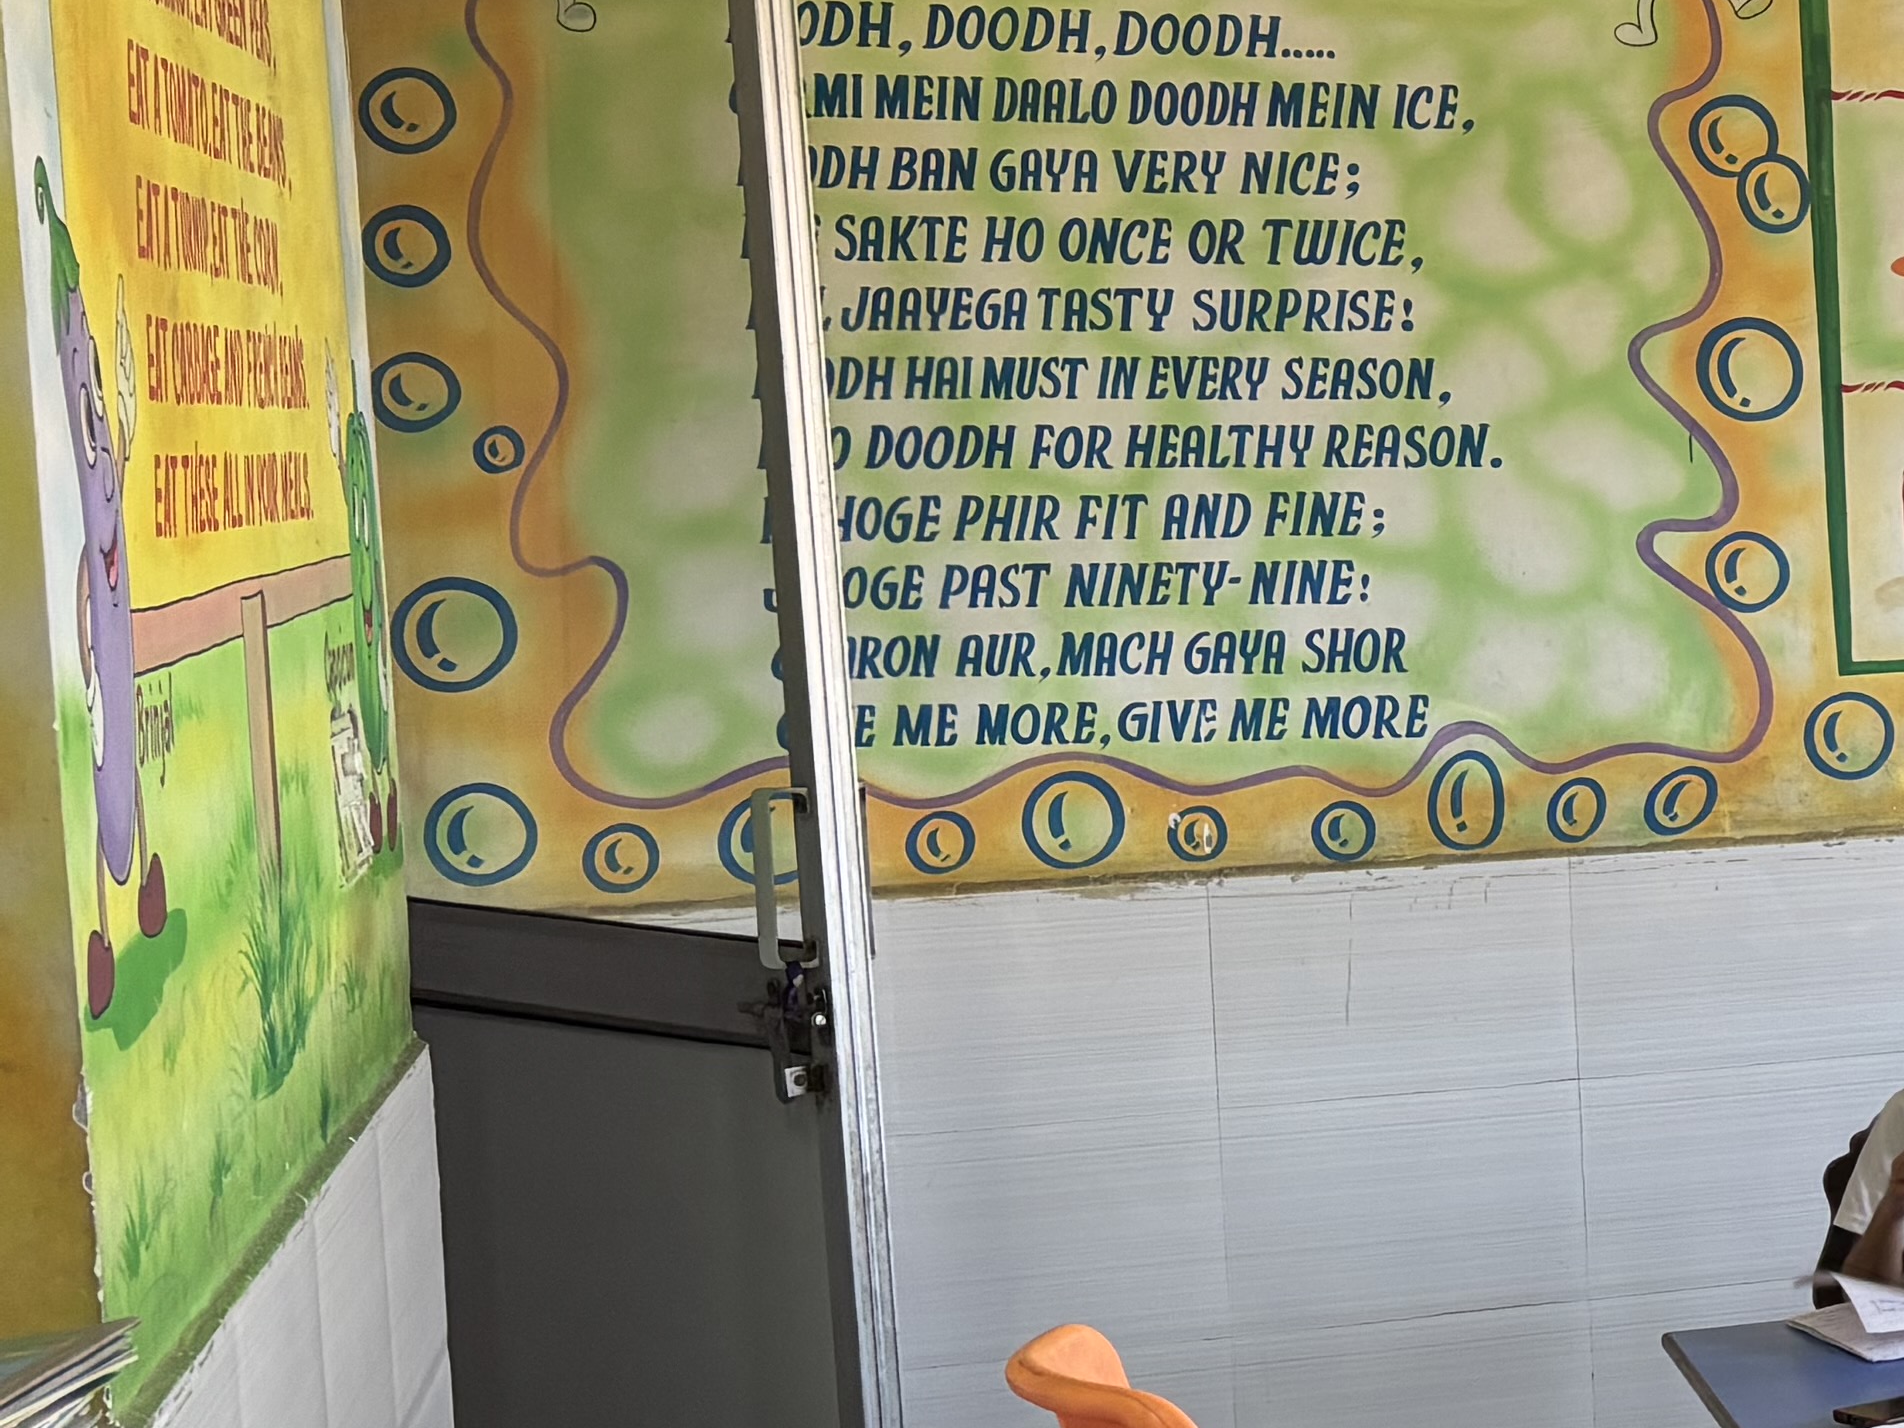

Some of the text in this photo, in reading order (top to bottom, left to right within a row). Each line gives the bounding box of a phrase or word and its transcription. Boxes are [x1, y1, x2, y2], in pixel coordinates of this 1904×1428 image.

[798, 1, 911, 57] ODH,
[127, 38, 149, 130] EAT
[154, 53, 162, 137] A
[211, 82, 232, 164] EAT
[232, 93, 255, 174] THE
[876, 74, 984, 123] MEIN
[993, 76, 1118, 124] DAALO
[1128, 79, 1258, 127] DOODH
[1267, 81, 1379, 129] MEIN
[1393, 83, 1476, 136] ICE,
[891, 147, 977, 192] BAN
[989, 150, 1099, 192] GAYA
[1114, 151, 1227, 194] VERY
[135, 175, 162, 267] EAT
[163, 184, 171, 270] A
[210, 201, 230, 280] EAT
[834, 215, 969, 262] SAKTE
[983, 217, 1046, 263] HO
[1058, 218, 1172, 263] ONCE
[1187, 218, 1246, 265] OR
[841, 287, 1028, 332] JAAYEGA
[1038, 287, 1173, 332] TASTY
[146, 314, 168, 405] EAT
[171, 317, 222, 407] CABBAGE
[224, 327, 244, 407] AND
[904, 356, 973, 400] HAI
[981, 356, 1088, 400] MUST
[1097, 357, 1136, 400] IN
[1145, 356, 1270, 401] EVERY
[1280, 358, 1452, 408] SEASON,
[866, 425, 1015, 470] DOODH
[1029, 425, 1113, 470] FOR
[1125, 425, 1316, 470] HEALTHY
[1324, 424, 1503, 470] REASON.
[154, 453, 178, 538] EAT
[181, 440, 220, 536] THESE
[223, 451, 244, 529] ALL
[244, 454, 255, 527] IN
[838, 496, 942, 543] HOGE
[953, 495, 1061, 542] PHIR
[1075, 494, 1149, 541] FIT
[1161, 493, 1251, 540] AND
[844, 564, 924, 611] OGE
[939, 563, 1051, 610] PAST
[849, 633, 941, 679] RON
[1057, 631, 1174, 677] MACH
[1184, 630, 1286, 676] GAYA
[1302, 628, 1408, 673] SHOR
[136, 671, 175, 788] Brinjal
[894, 704, 959, 748] ME
[1118, 701, 1218, 744] GIVE
[1228, 698, 1289, 741] ME
[1301, 695, 1429, 740] MORE
